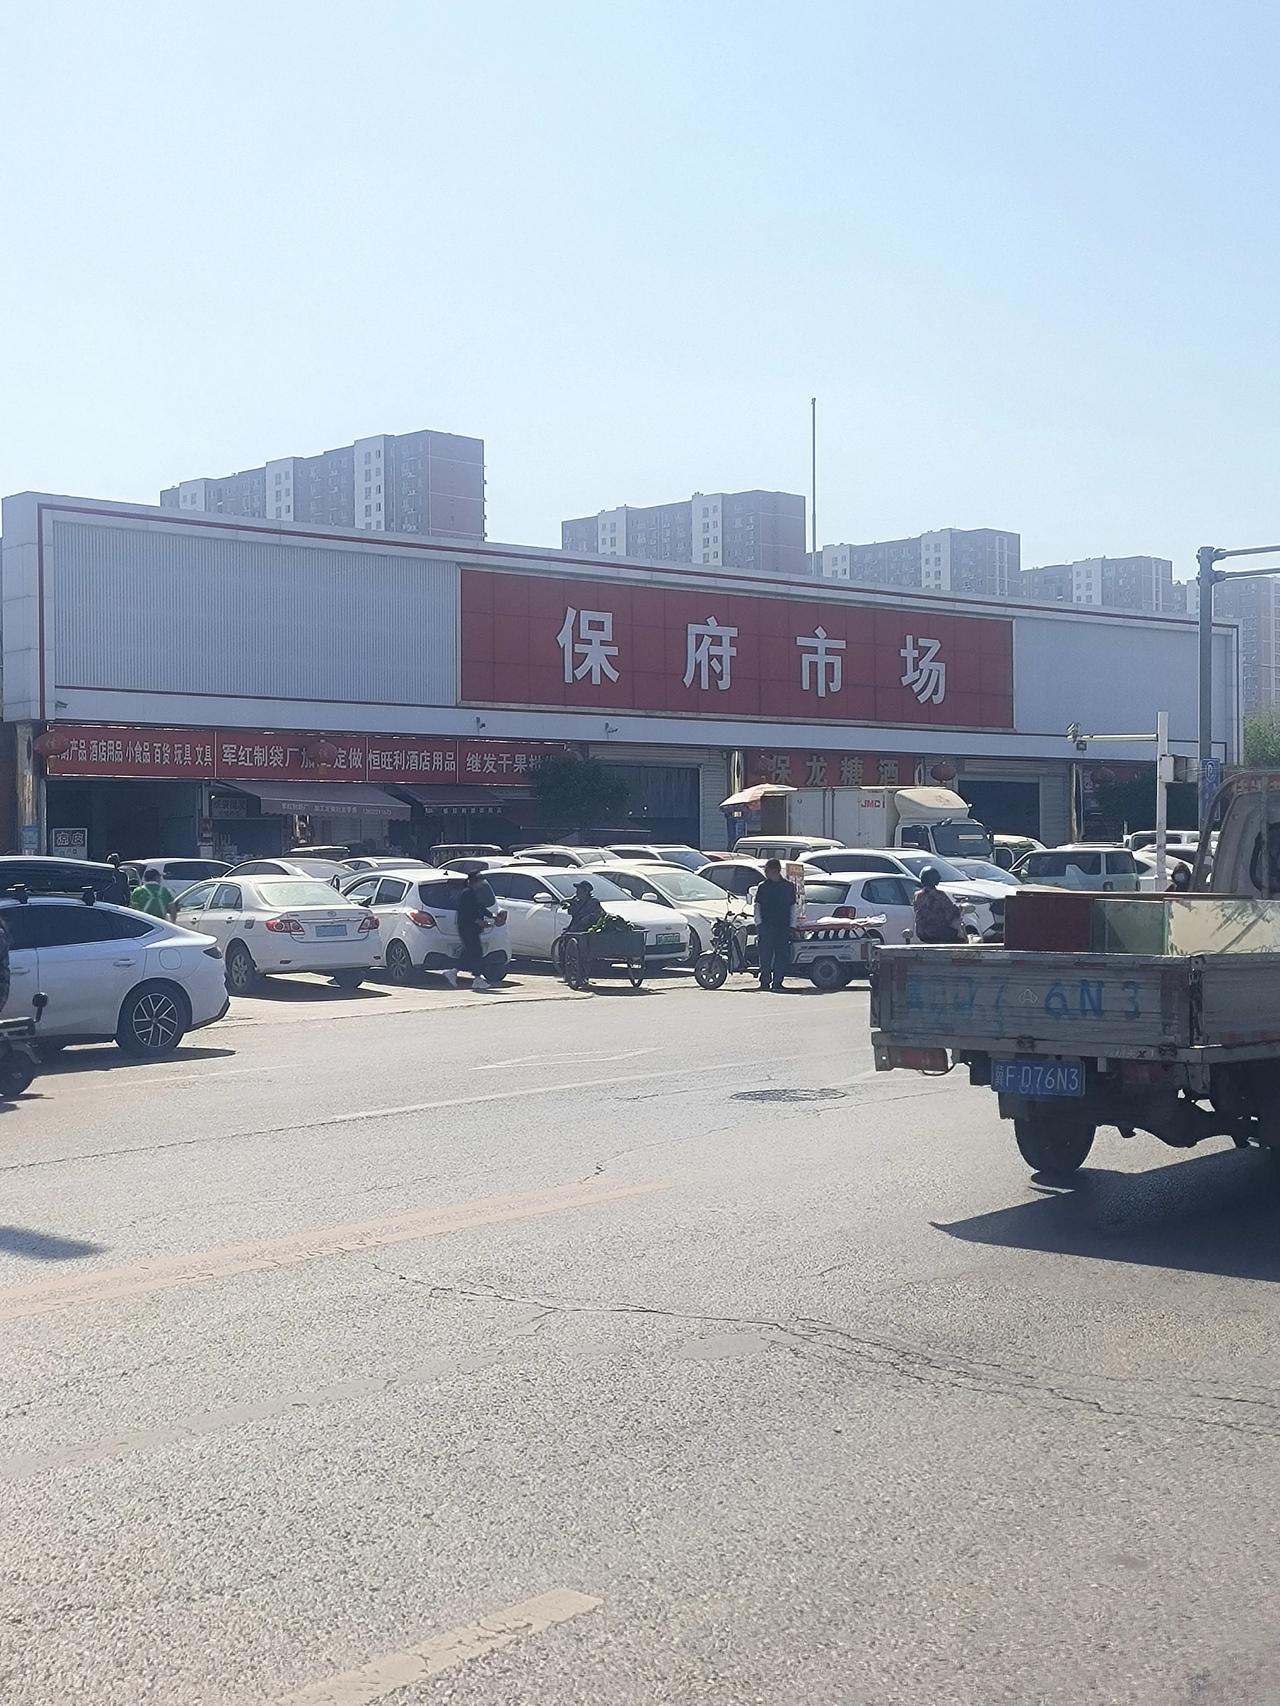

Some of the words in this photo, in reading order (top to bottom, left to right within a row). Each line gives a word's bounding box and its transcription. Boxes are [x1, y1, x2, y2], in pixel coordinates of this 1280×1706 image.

[557, 606, 947, 705] 保府市场
[89, 739, 123, 763] 酒店用品
[126, 741, 151, 764] 小食品
[153, 743, 171, 765] 百货
[173, 744, 192, 766] 玩具
[195, 745, 213, 767] 文具
[222, 744, 363, 768] 军红制袋厂加定做
[367, 748, 456, 772] 恒旺利酒店用品
[466, 751, 553, 774] 继发干果批
